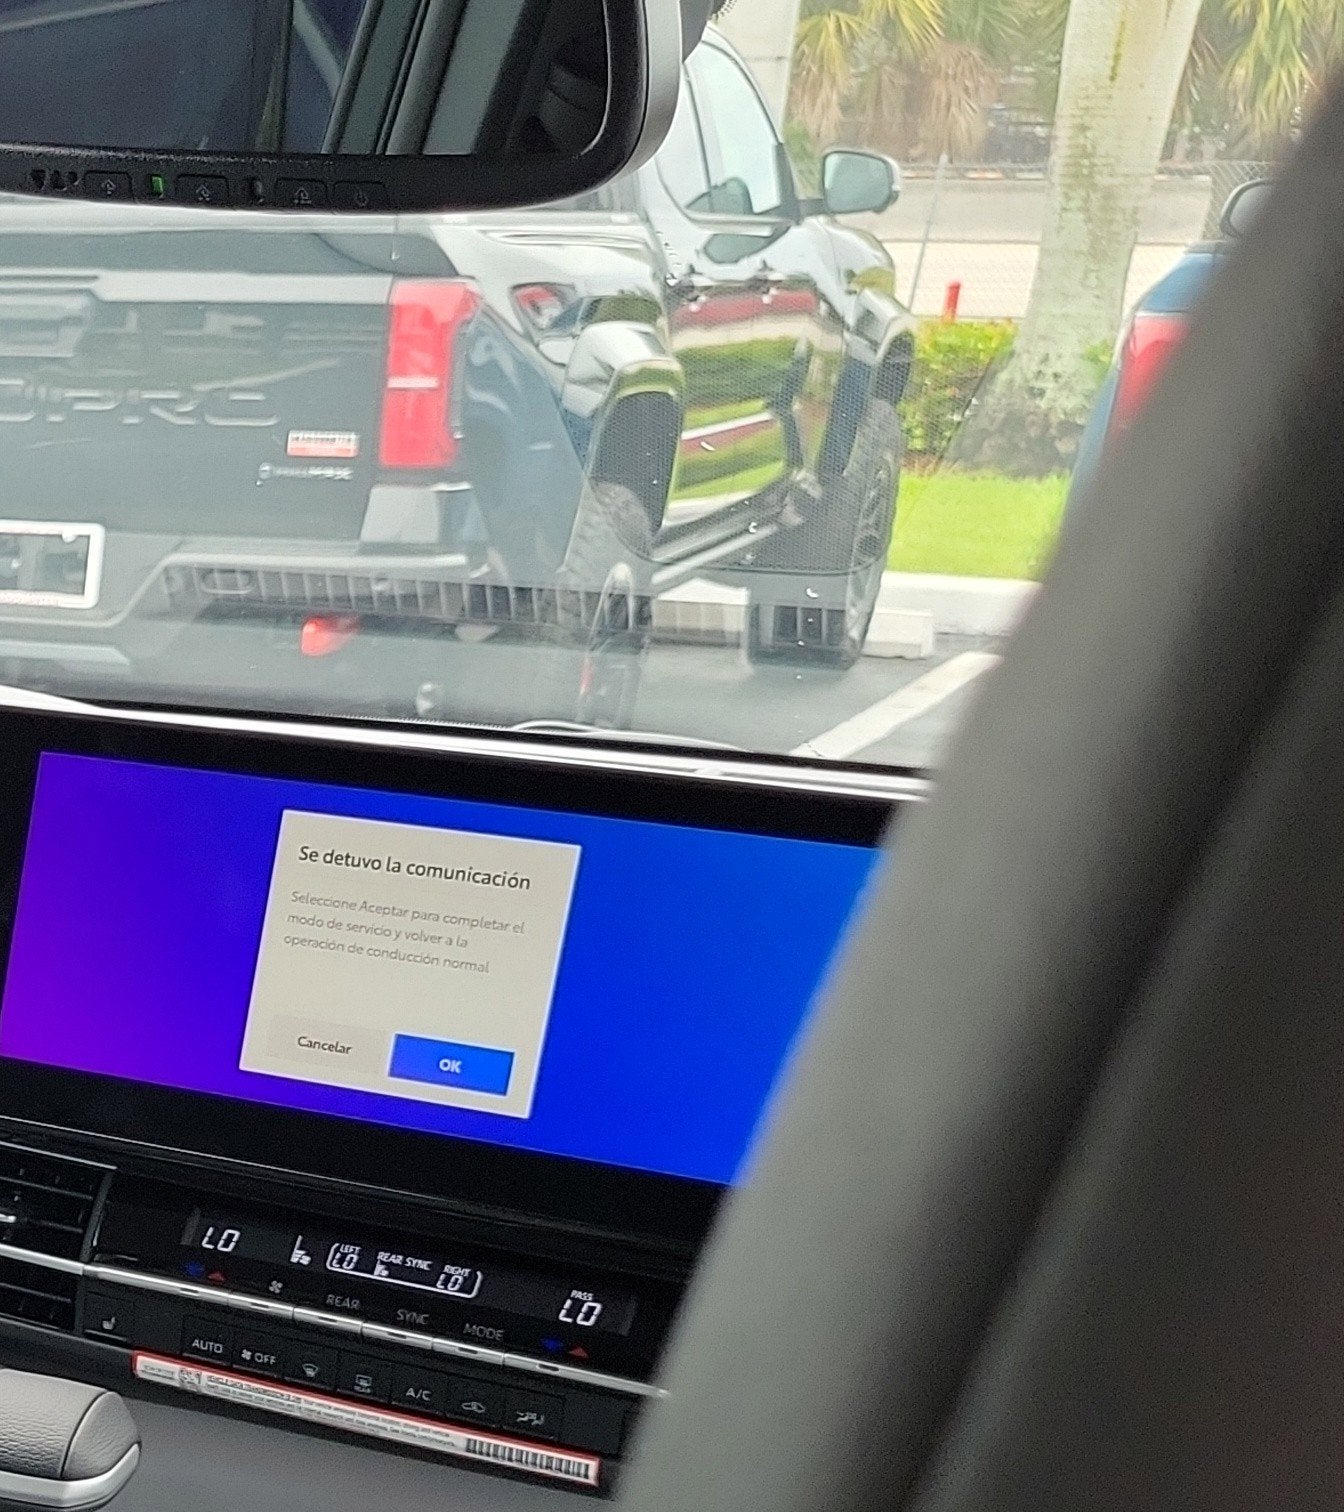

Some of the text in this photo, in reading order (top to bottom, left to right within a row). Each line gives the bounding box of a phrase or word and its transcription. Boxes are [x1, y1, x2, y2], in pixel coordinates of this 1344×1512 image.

[298, 845, 531, 890] Se detuvo la comunicación
[291, 891, 526, 934] Seleccione Aceptar para completar el
[287, 913, 468, 949] modo de servicio y volver a la
[284, 934, 489, 973] operación de conducción normal
[297, 1036, 353, 1056] Cancelar
[439, 1058, 462, 1074] OK
[201, 1226, 241, 1252] LO
[339, 1243, 362, 1255] LEFT
[332, 1253, 359, 1271] LO
[377, 1251, 433, 1271] REAR SYNC
[443, 1264, 472, 1278] RIGHT
[435, 1273, 462, 1291] LO
[326, 1294, 360, 1309] REAR
[570, 1289, 595, 1301] PASS
[397, 1309, 430, 1325] SYNC
[558, 1299, 603, 1327] LO
[463, 1323, 505, 1341] MODE
[192, 1339, 224, 1354] AUTO
[254, 1352, 276, 1365] OFF
[406, 1387, 432, 1401] A/C
